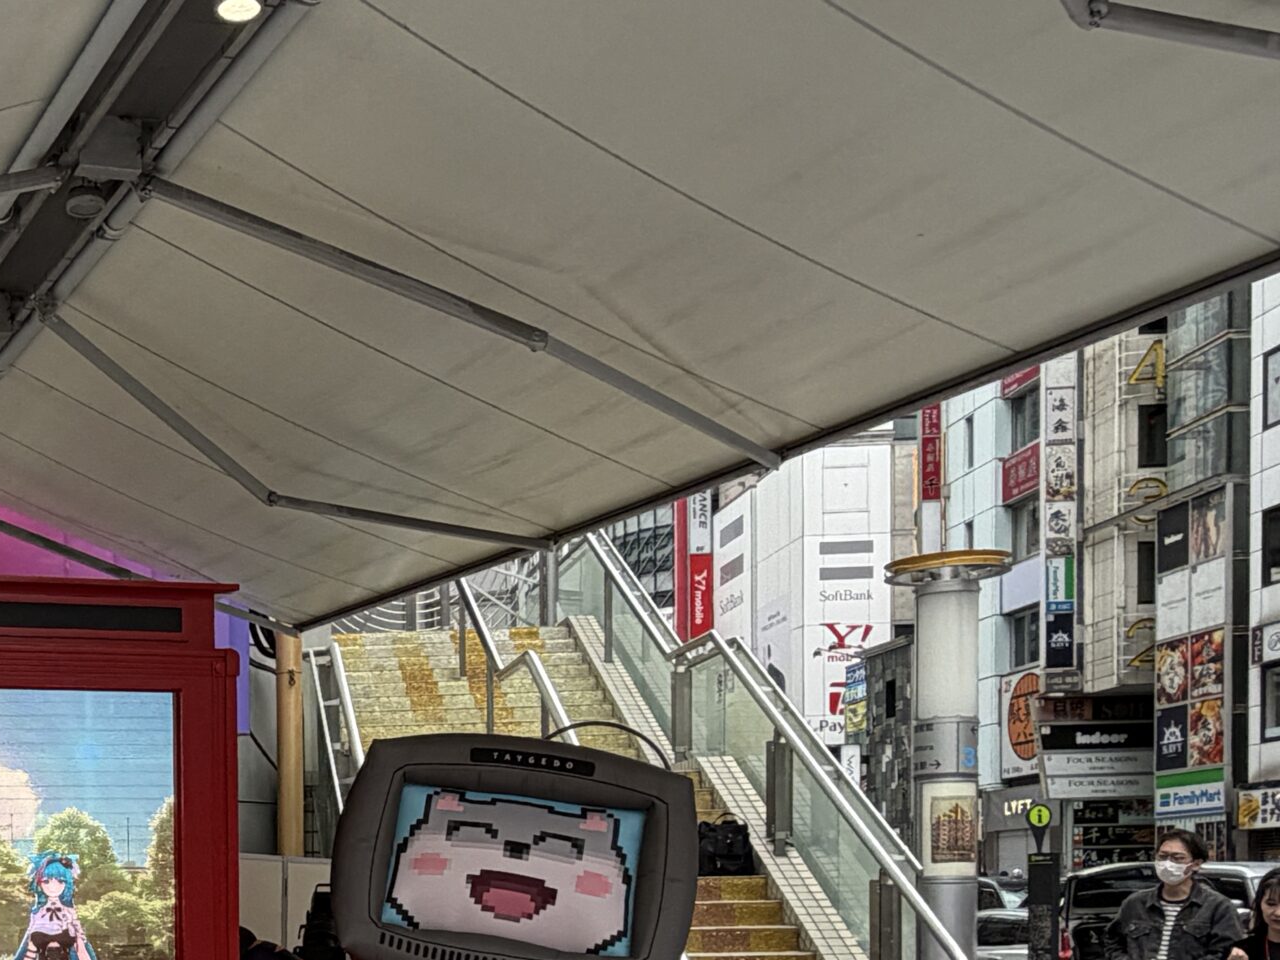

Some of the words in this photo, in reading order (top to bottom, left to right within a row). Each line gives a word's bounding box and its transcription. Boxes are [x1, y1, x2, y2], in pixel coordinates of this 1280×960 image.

[698, 491, 708, 529] ANCE
[819, 589, 874, 602] SoftBank
[493, 751, 574, 769] TAYGEDO
[1173, 788, 1221, 806] FamilyMart
[1004, 799, 1032, 815] LYFT
